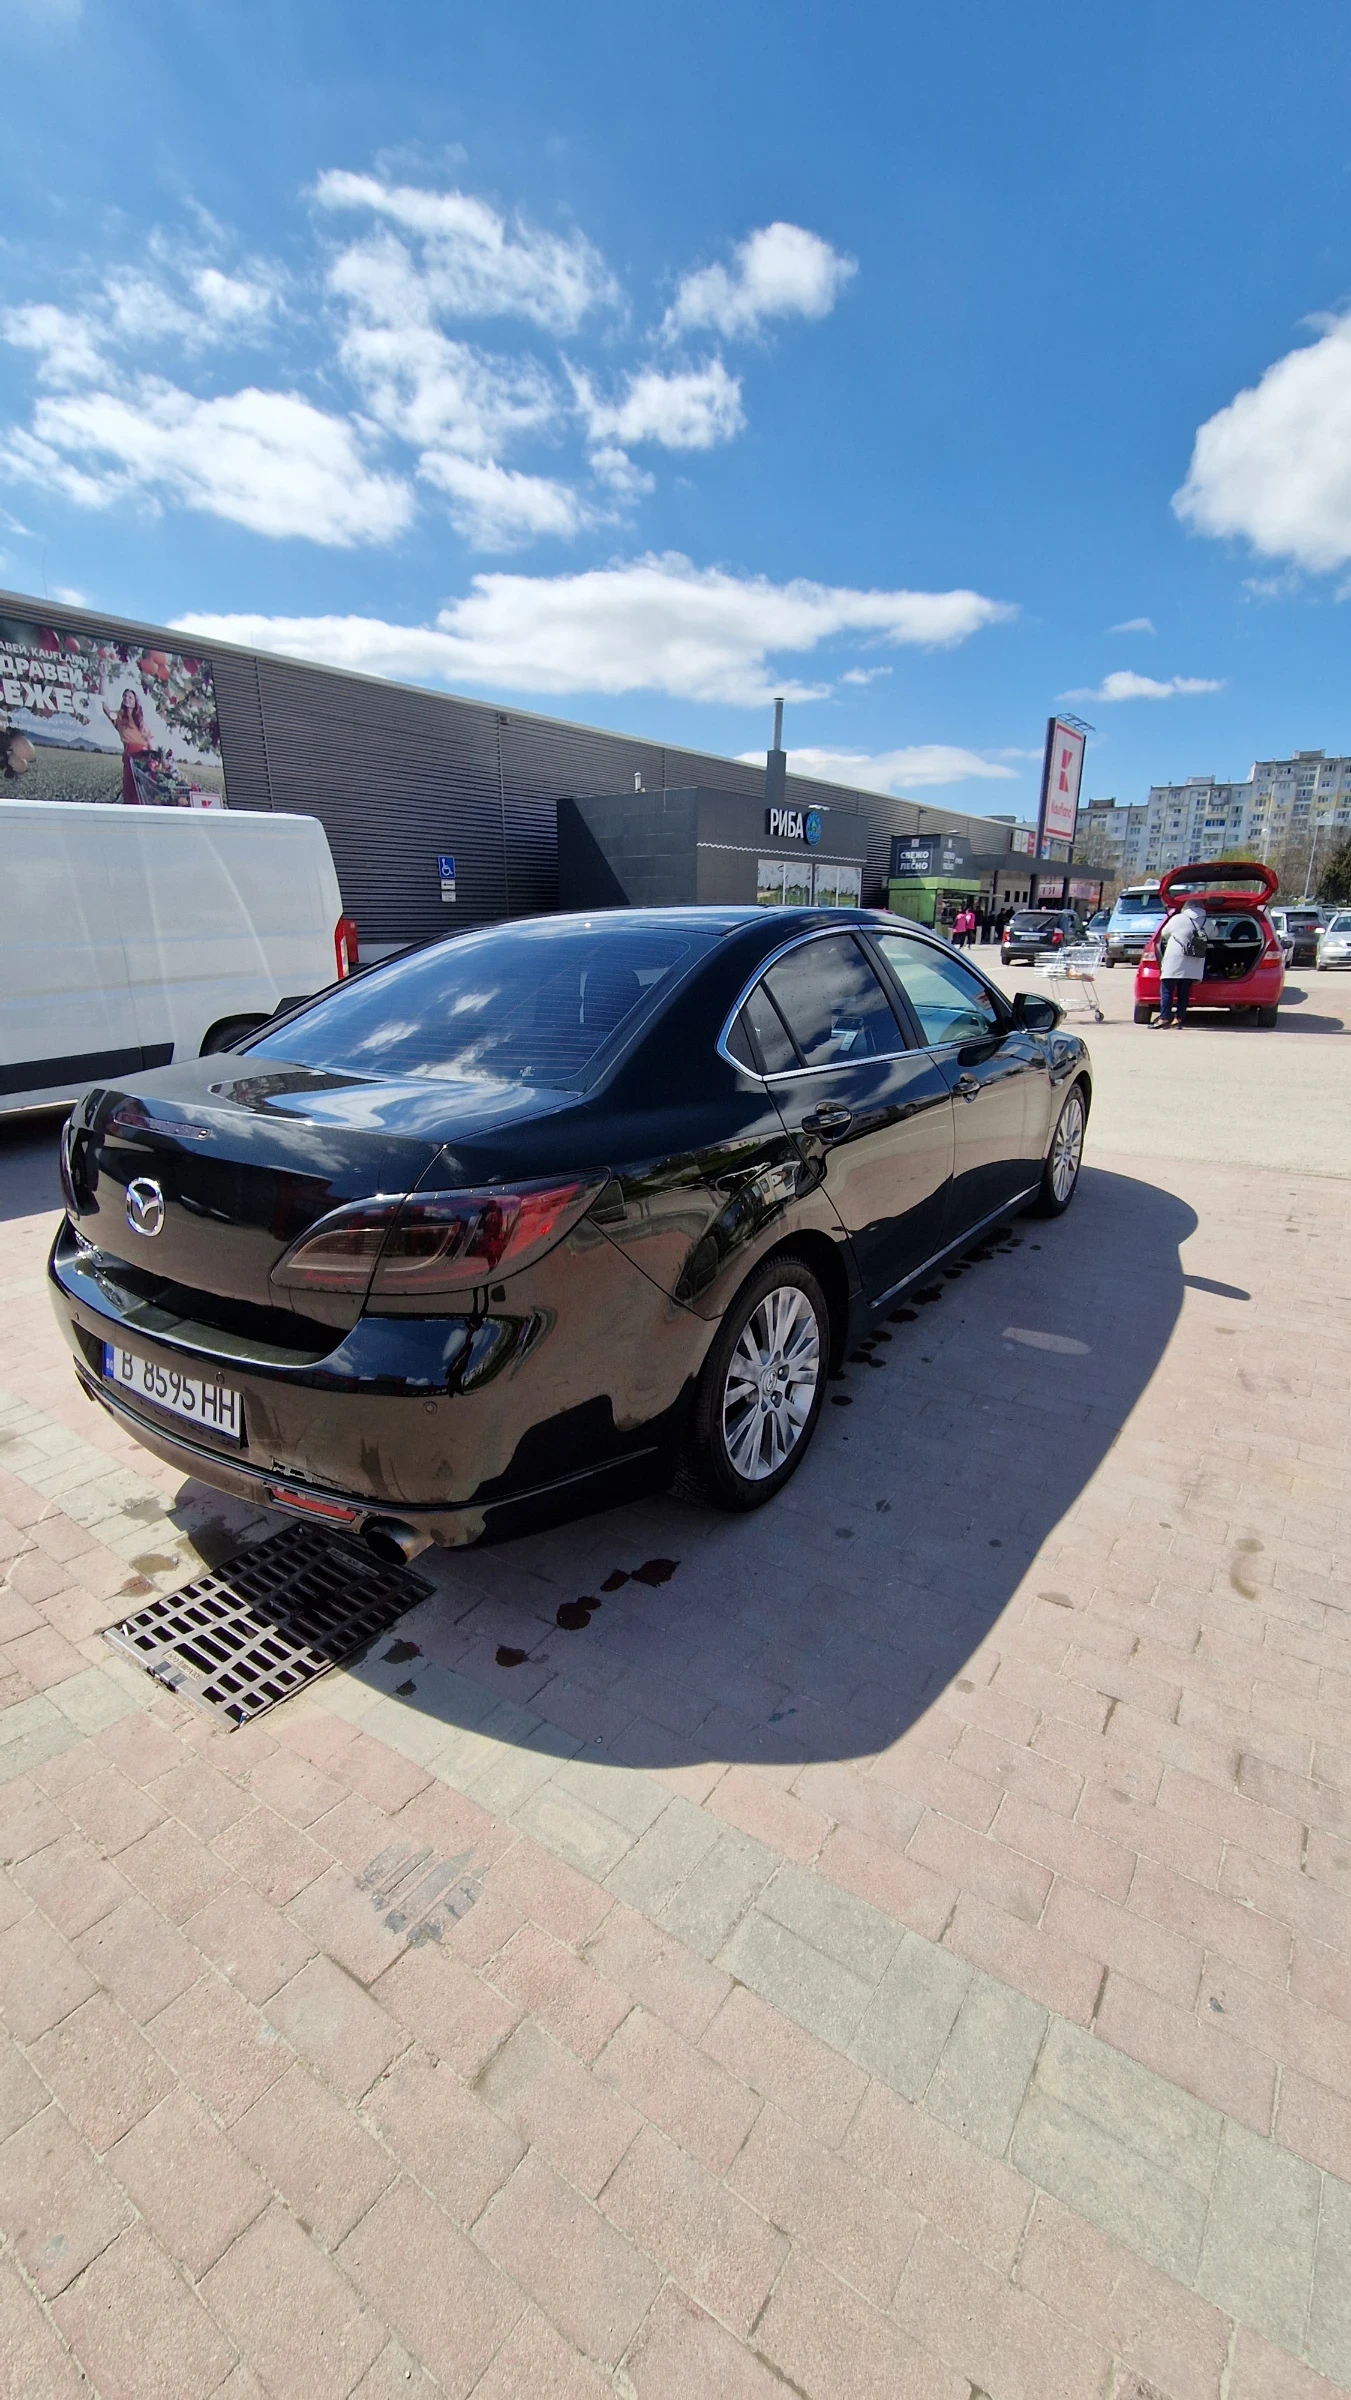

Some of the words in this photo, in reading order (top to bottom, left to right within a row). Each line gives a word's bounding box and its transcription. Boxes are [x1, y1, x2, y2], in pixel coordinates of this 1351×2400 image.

[770, 808, 804, 839] РИБА
[900, 851, 929, 859] СВЕЖО
[899, 862, 928, 870] ЛЕСНО
[143, 1360, 196, 1411] 8595
[201, 1382, 235, 1429] HH
